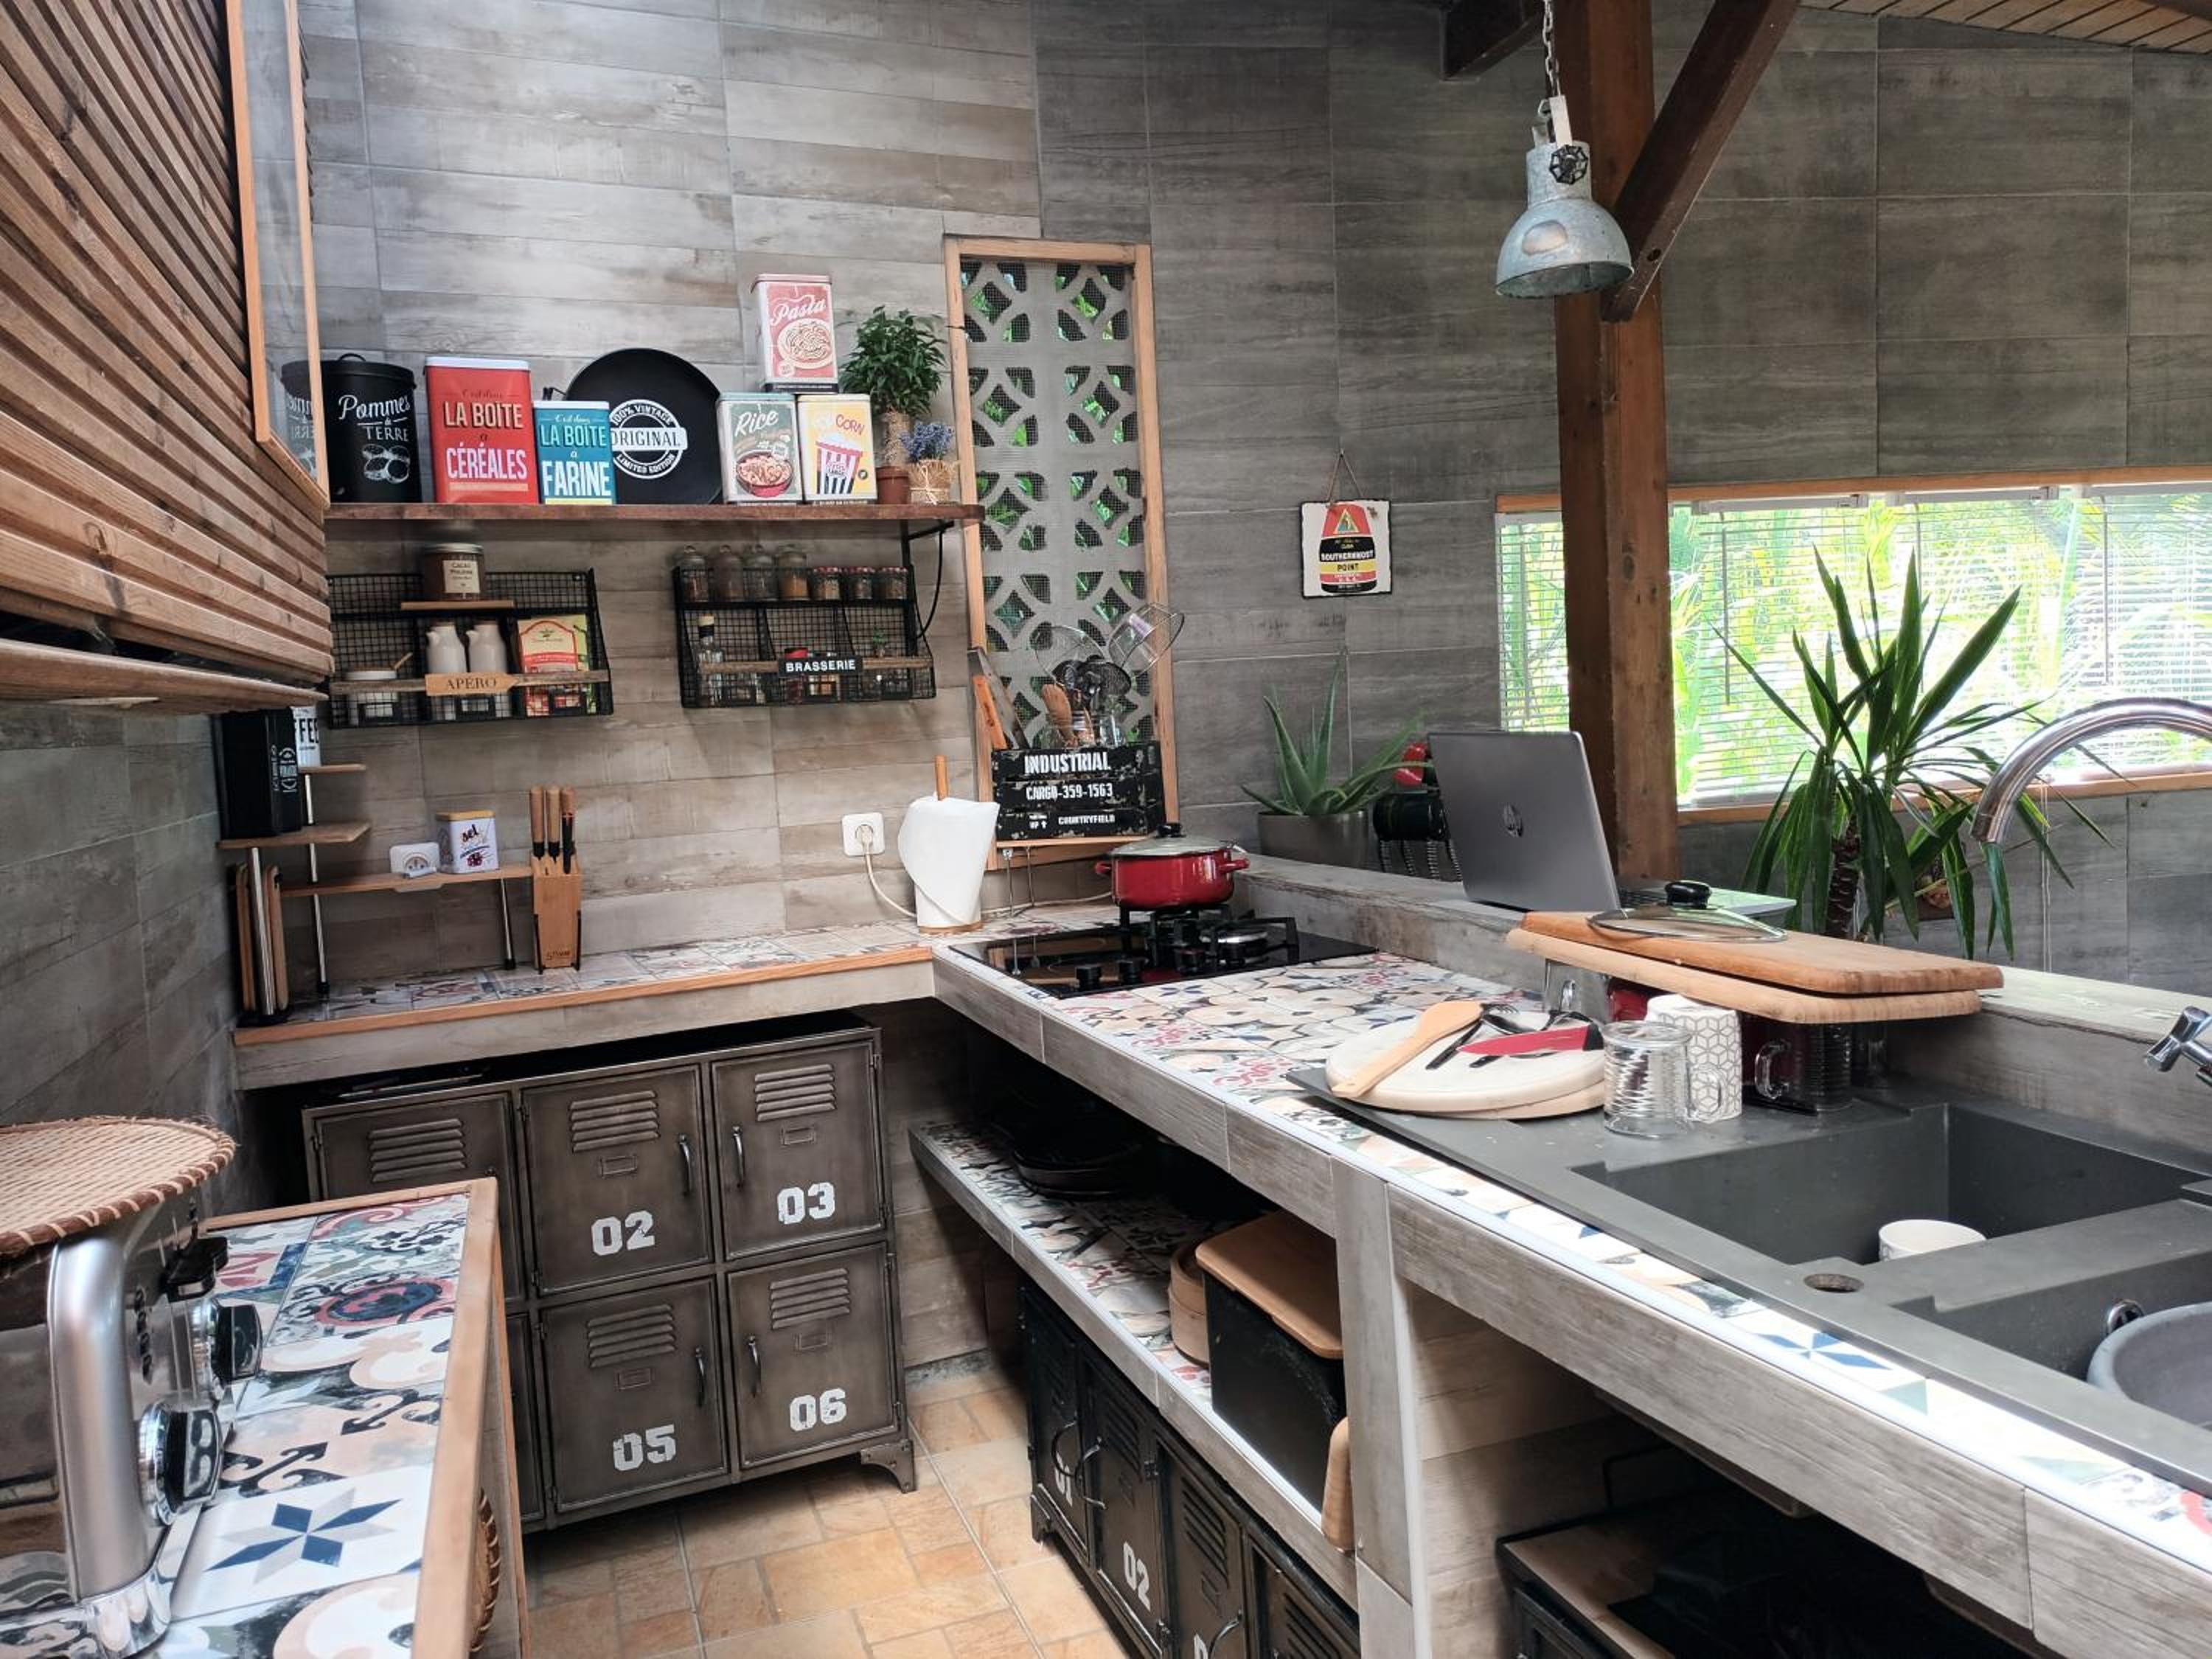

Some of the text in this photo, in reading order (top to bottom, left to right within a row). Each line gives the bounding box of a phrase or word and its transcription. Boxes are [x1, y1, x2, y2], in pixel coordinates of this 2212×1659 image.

[770, 299, 827, 326] Pasta
[338, 394, 410, 420] Pommes
[444, 401, 468, 428] LA
[612, 405, 673, 426] 100% VINTAGE
[363, 425, 408, 442] TERRE
[540, 424, 560, 447] LA
[734, 410, 779, 437] Rice
[835, 414, 865, 435] CORN
[446, 442, 528, 480] CÉRÉALES
[616, 453, 675, 474] LIMITED EDITION
[542, 461, 611, 496] FARINE
[1337, 563, 1359, 572] POINT
[786, 659, 856, 672] BRASSERIE
[446, 676, 497, 689] APÉRO
[1024, 751, 1111, 775] INDUSTRIAL
[1058, 815, 1116, 825] COUNTRYFIELD
[462, 824, 479, 843] sel
[777, 1182, 835, 1225] 03
[591, 1210, 655, 1256] 02
[790, 1388, 847, 1431] 06
[613, 1424, 676, 1471] 05
[1123, 1541, 1151, 1611] 02
